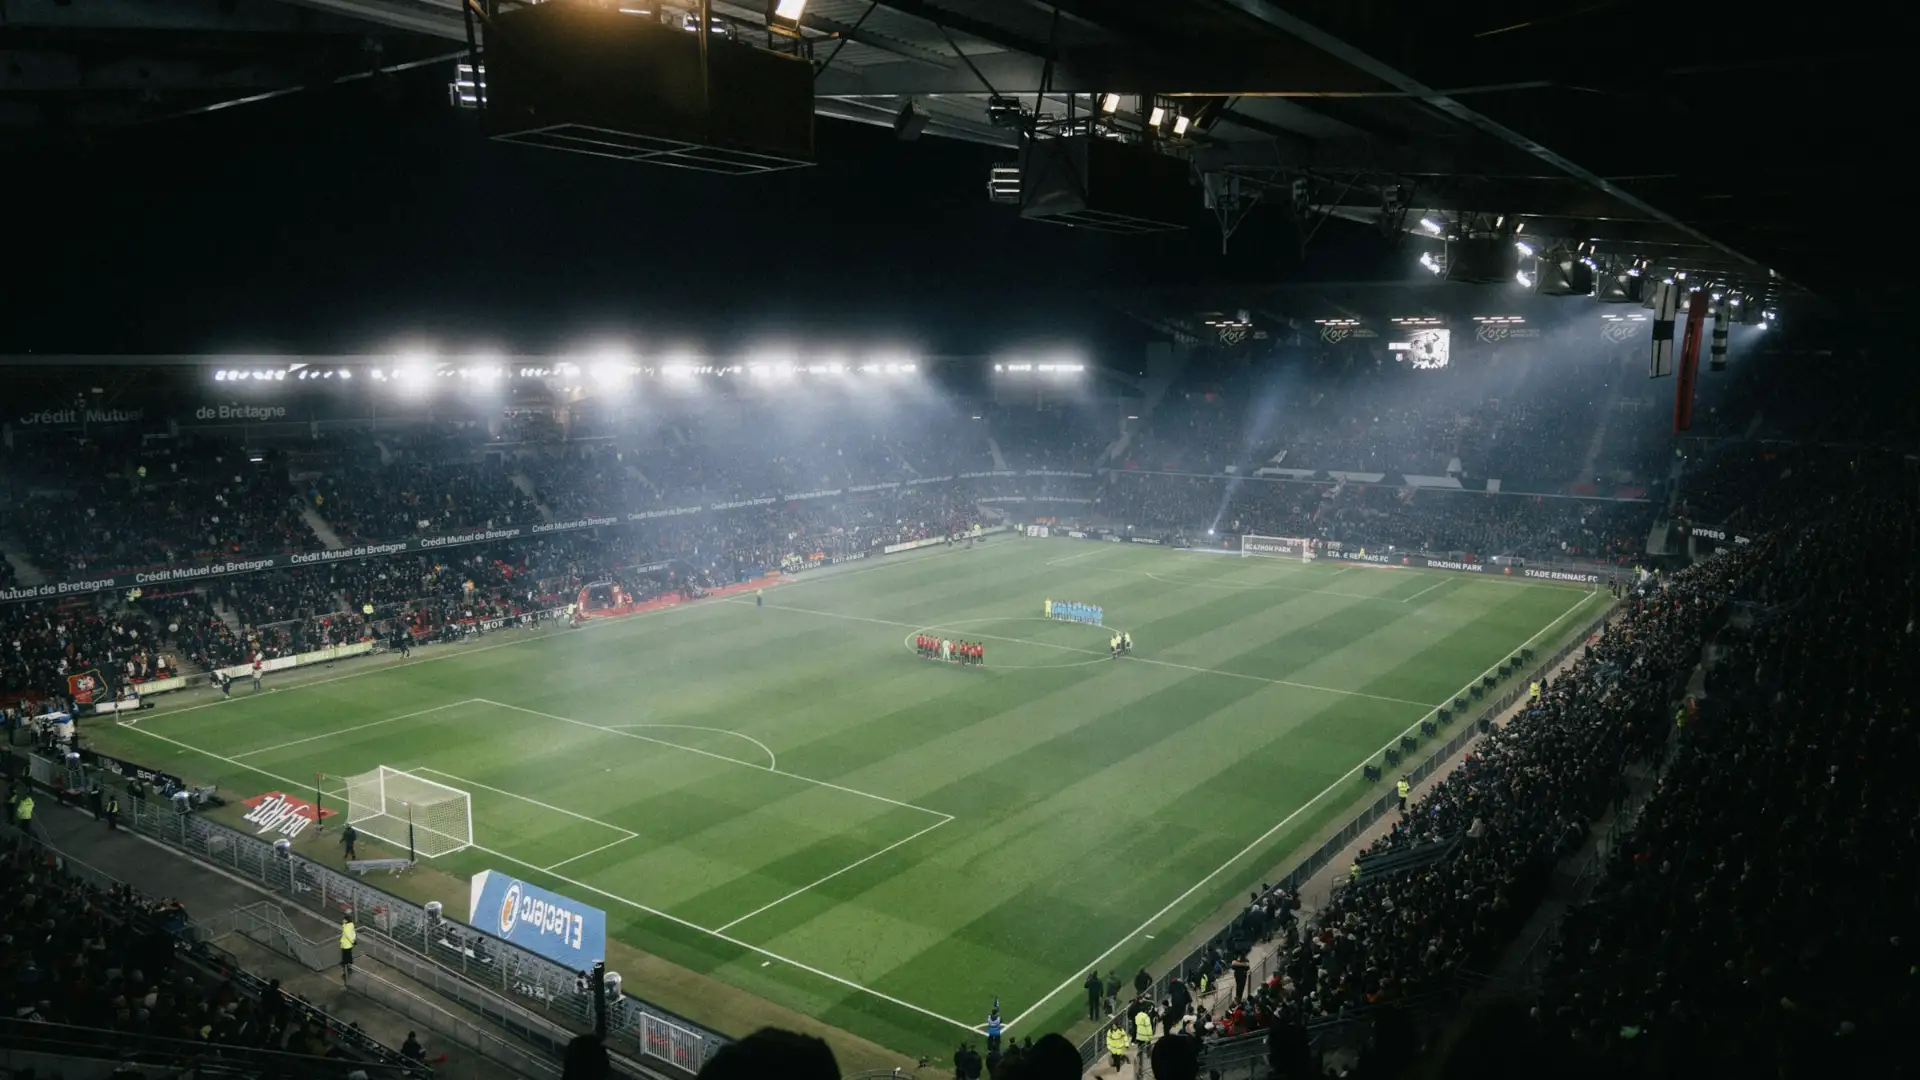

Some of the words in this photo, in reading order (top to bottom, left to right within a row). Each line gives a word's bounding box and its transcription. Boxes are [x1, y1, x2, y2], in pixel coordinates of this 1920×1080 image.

[196, 405, 216, 420] de
[219, 405, 286, 421] Bretagne
[420, 537, 447, 548] Crédit
[447, 532, 474, 544] Mutuel
[475, 530, 485, 540] de
[291, 552, 320, 564] Crédit
[321, 547, 353, 560] Mutuel
[354, 545, 366, 556] de
[367, 541, 407, 555] Bretagne
[1274, 546, 1292, 554] PARK
[1379, 555, 1389, 563] FC
[1427, 559, 1461, 570] ROAZHON
[1462, 563, 1483, 572] PARK
[135, 569, 171, 583] Crédit
[172, 564, 210, 579] Mutuel
[211, 563, 225, 574] de
[226, 559, 274, 573] Bretagne
[1524, 569, 1550, 579] STADE
[1551, 571, 1586, 582] RENNAIS
[1587, 575, 1599, 583] FC
[39, 584, 56, 595] de
[58, 578, 115, 593] Bretagne
